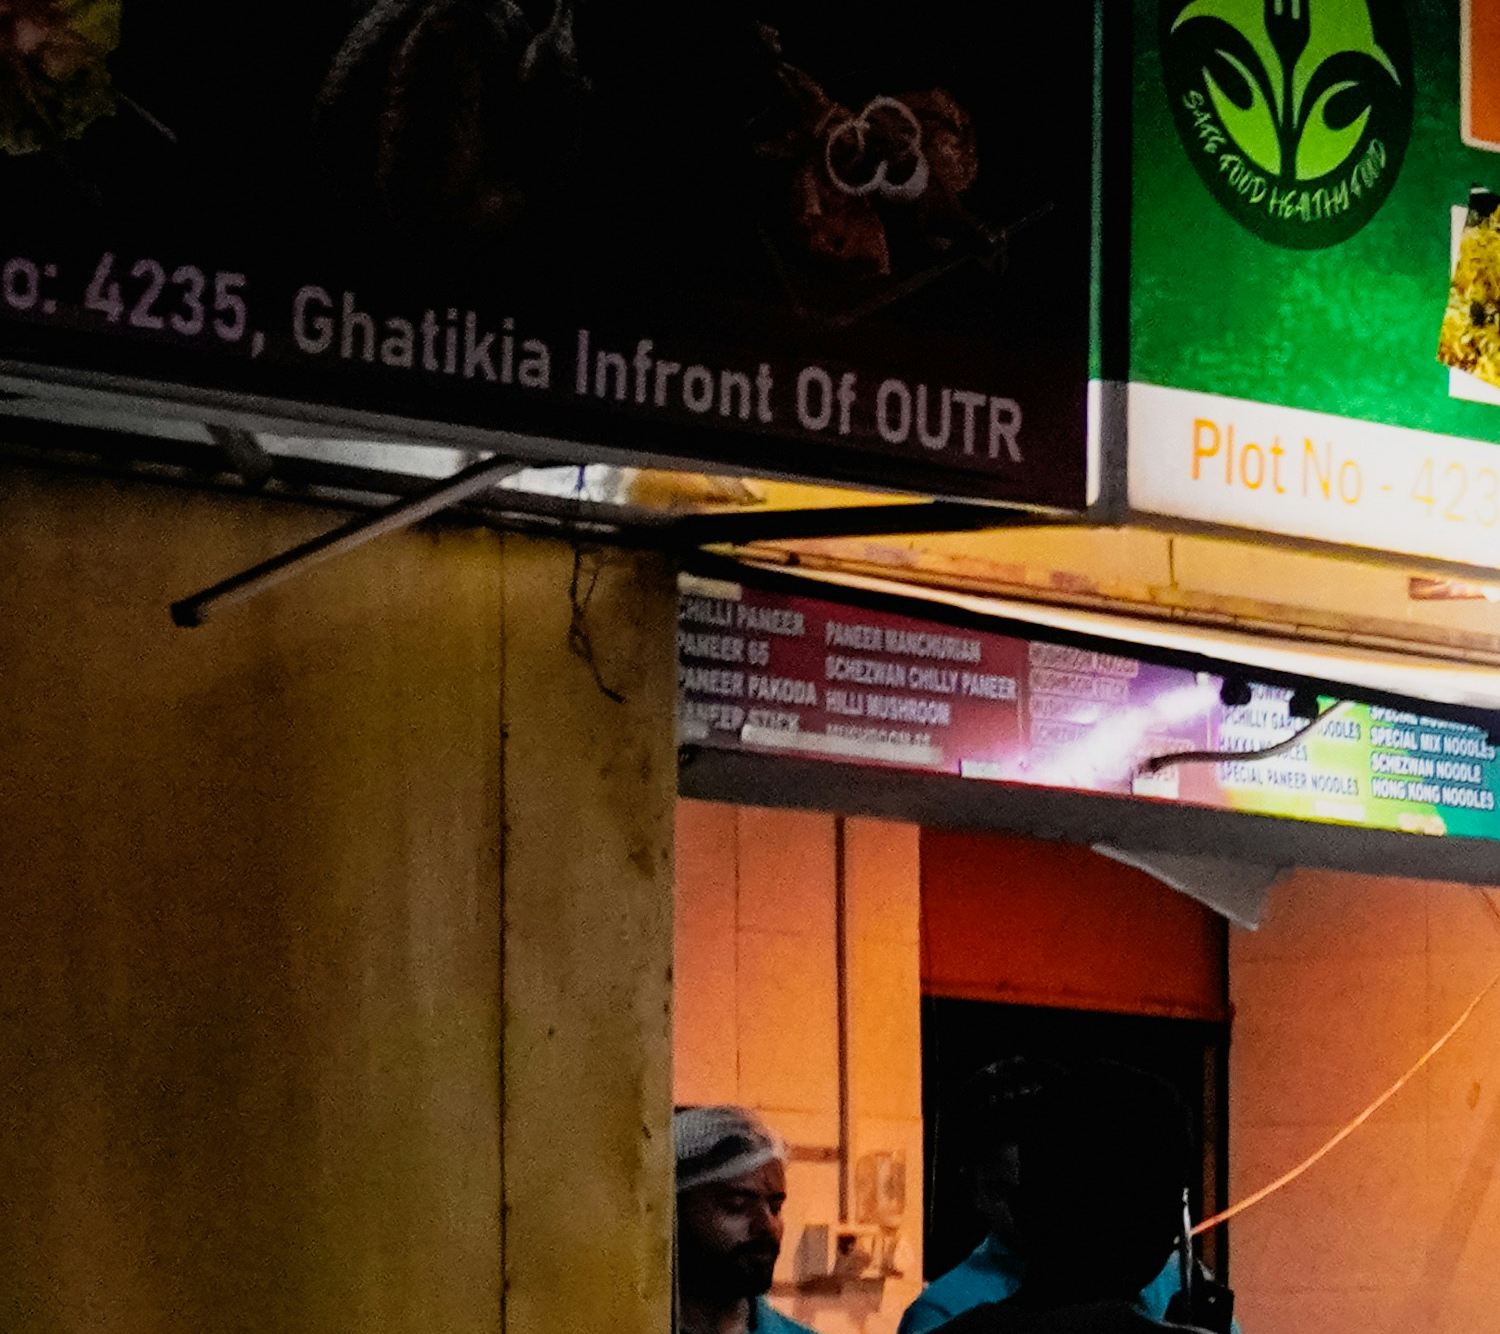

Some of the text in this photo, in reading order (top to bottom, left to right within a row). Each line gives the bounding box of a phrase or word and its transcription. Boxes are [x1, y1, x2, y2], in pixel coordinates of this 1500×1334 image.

[83, 250, 266, 360] 4235,
[293, 285, 551, 391] Ghatikia
[574, 328, 774, 424] Infront
[798, 366, 859, 435] Of
[875, 377, 1024, 462] OUTR
[1191, 416, 1286, 496] Plot
[1300, 437, 1363, 506] No
[1370, 726, 1419, 751] SPECIAL
[1420, 732, 1442, 753] MIX
[1371, 751, 1435, 778] SCHEZWAN
[1267, 768, 1309, 790] PANEER
[1311, 775, 1360, 796] NOODLES
[1372, 778, 1495, 811] HONG KONG NOODLES
